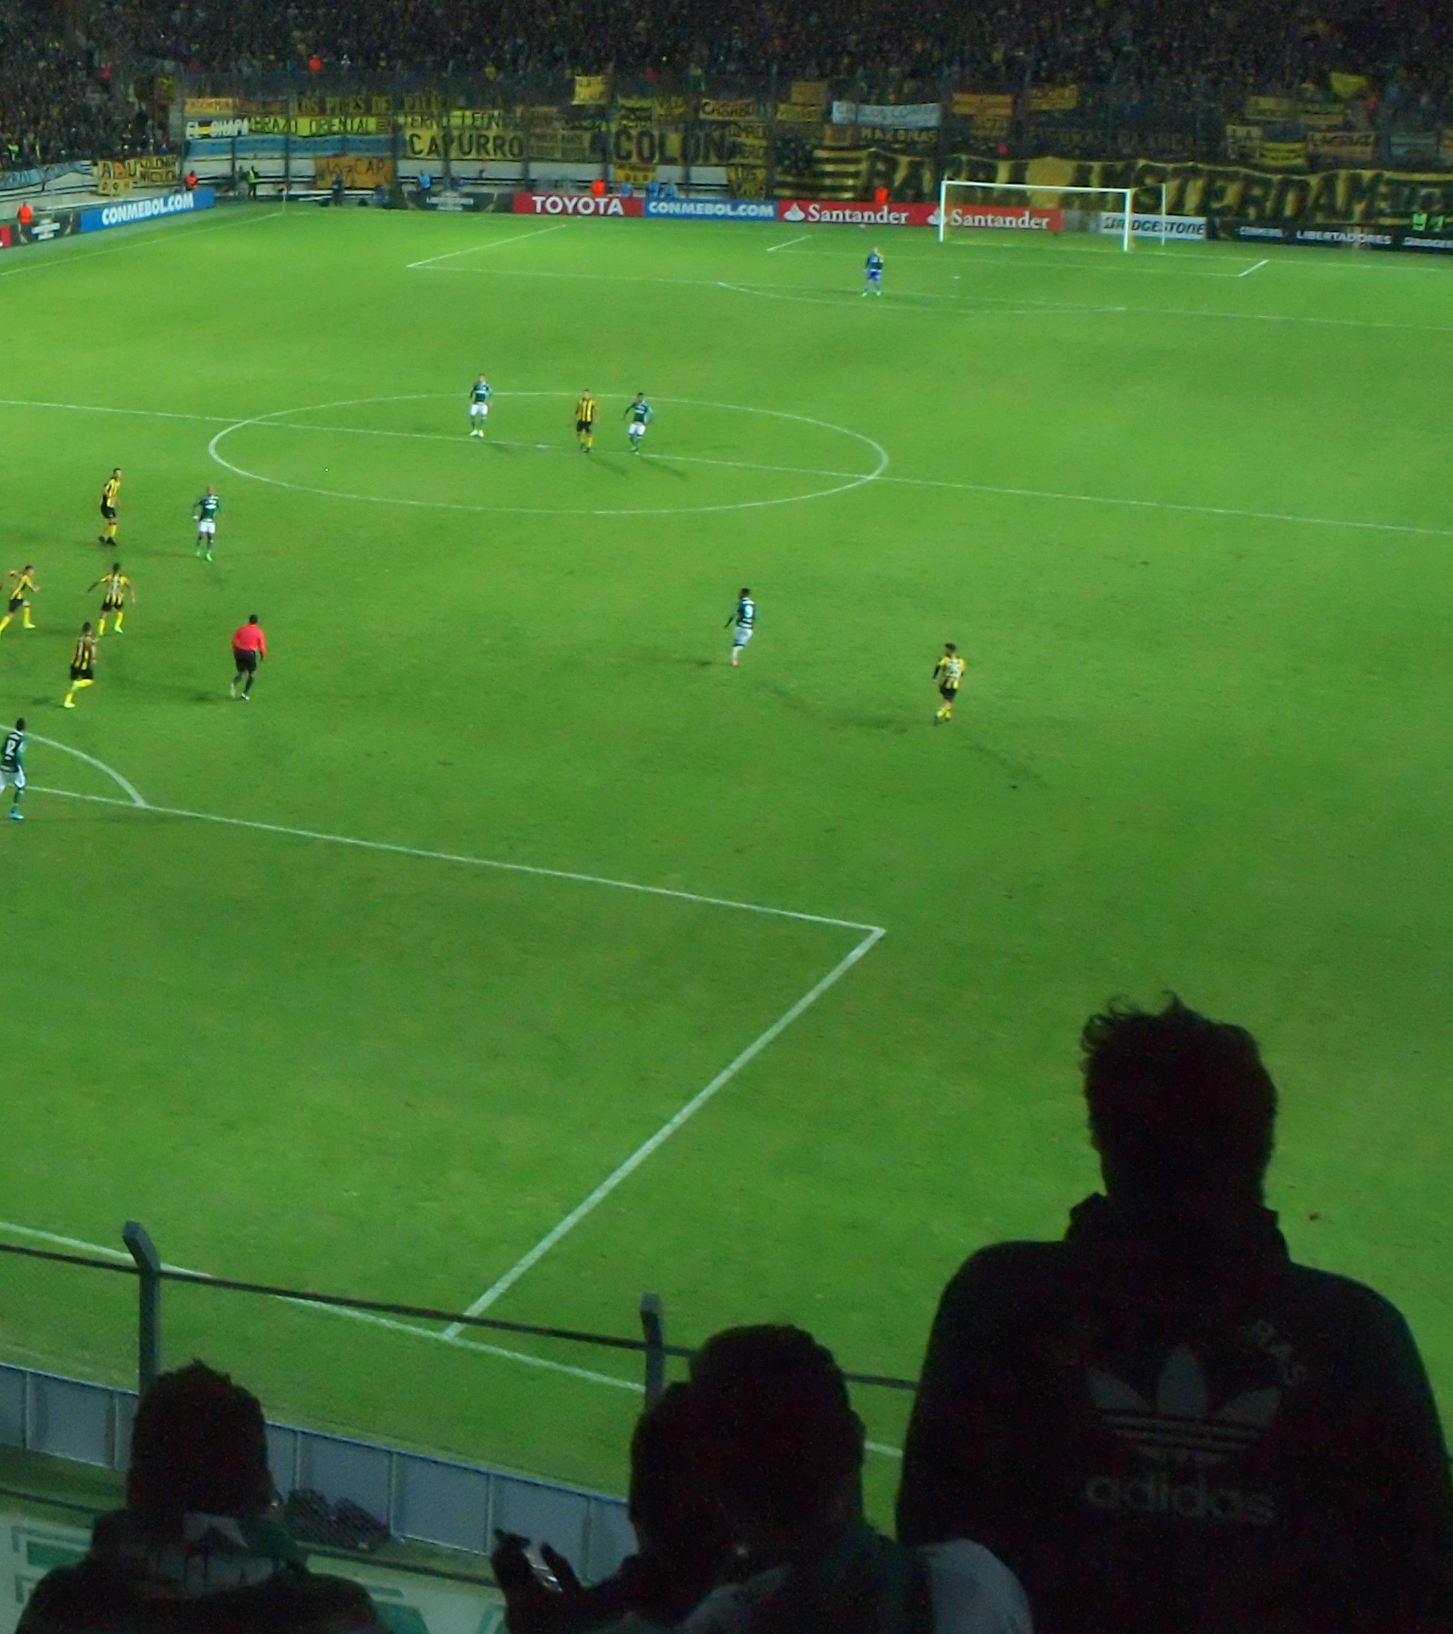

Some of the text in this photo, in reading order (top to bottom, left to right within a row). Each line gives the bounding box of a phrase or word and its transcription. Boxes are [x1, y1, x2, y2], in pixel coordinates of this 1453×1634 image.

[102, 193, 194, 226] CONMEBOL.COM
[532, 197, 624, 216] TOYOTA
[649, 201, 774, 218] CONMEBOL.COM
[808, 204, 910, 225] Santander
[951, 207, 1050, 231] Santander
[1085, 1473, 1276, 1530] adidas
